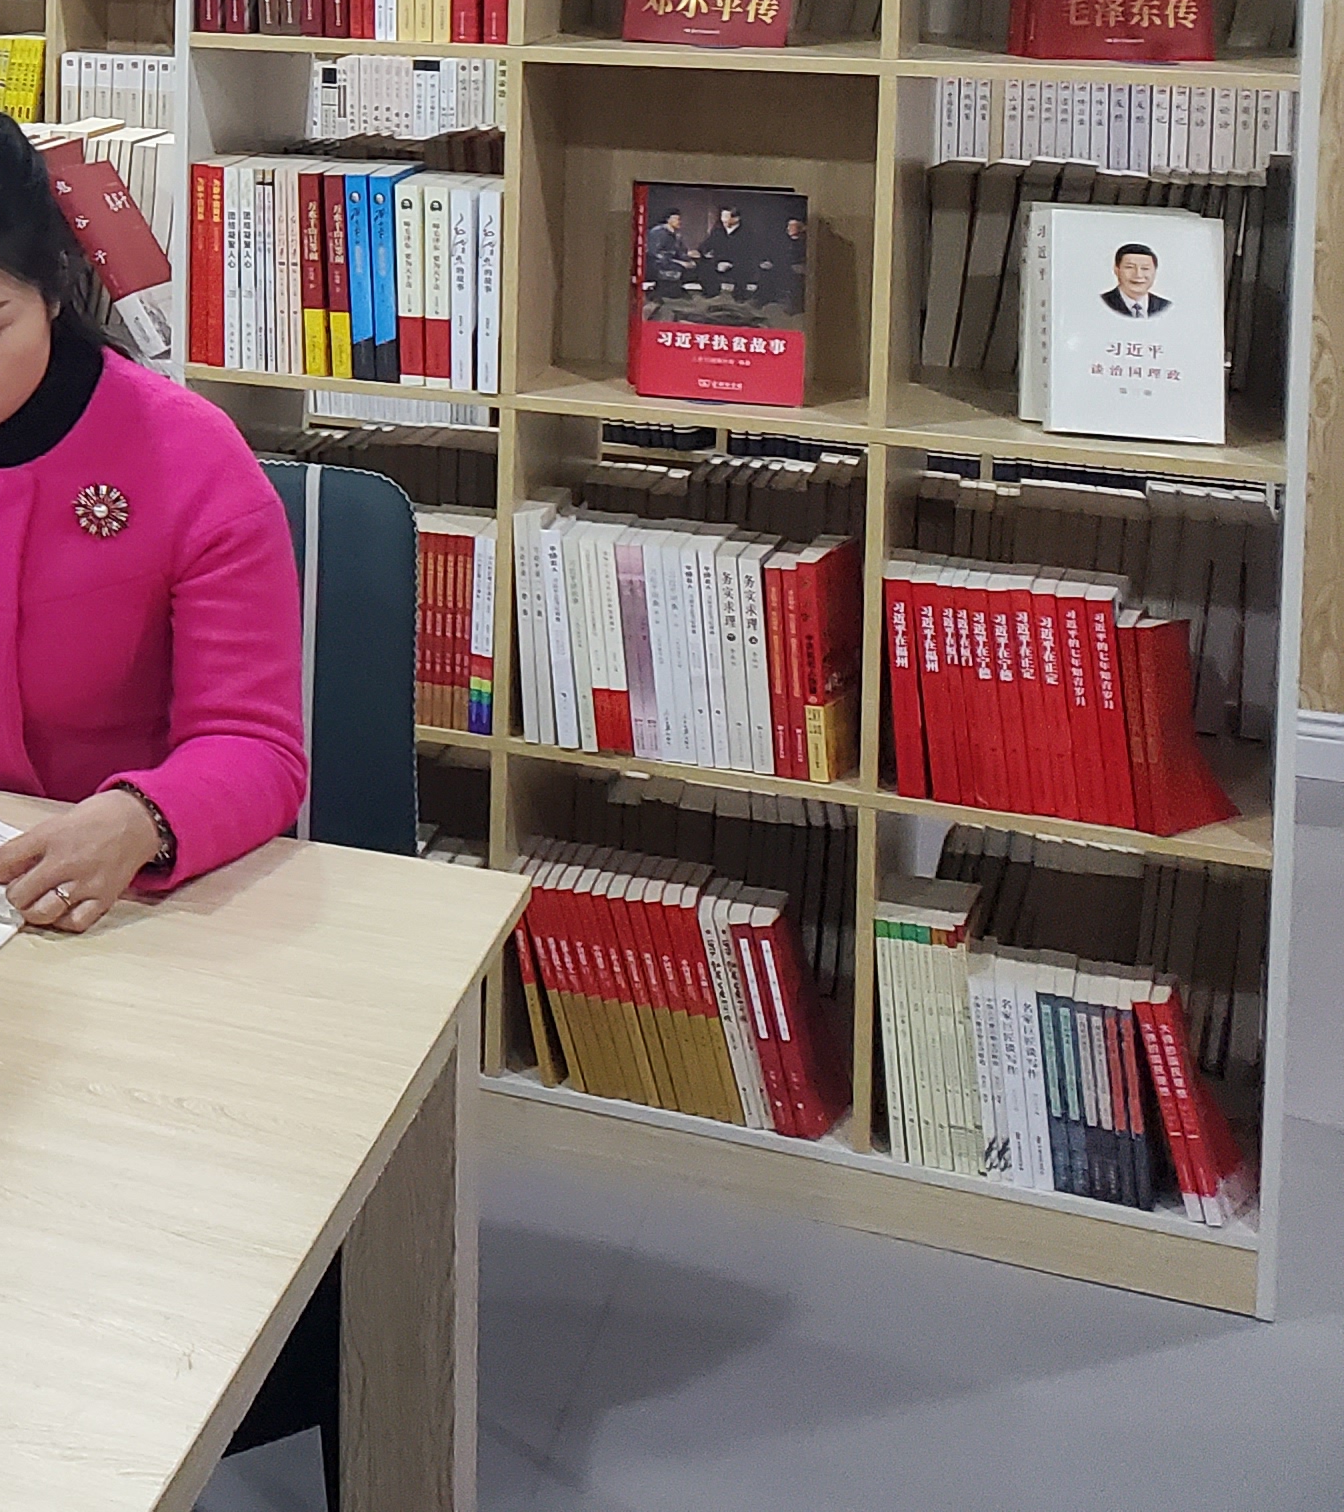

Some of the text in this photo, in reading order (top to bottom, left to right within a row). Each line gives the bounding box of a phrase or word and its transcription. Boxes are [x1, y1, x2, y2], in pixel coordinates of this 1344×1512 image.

[656, 330, 787, 355] 习近平扶贫故事
[1090, 363, 1182, 381] 谈治国理政
[1105, 342, 1164, 359] 习近平
[892, 601, 909, 669] 习近平在福州
[920, 605, 940, 673] 习近平在福州
[972, 611, 992, 680] 习近平在宁德
[991, 613, 1014, 683] 习近平在宁德
[1015, 610, 1035, 680] 习近平在正定
[1039, 616, 1059, 685] 习近平在正定
[1065, 609, 1086, 707] 习近平的七年知青岁月
[1093, 612, 1114, 710] 习近平的七年知青岁月
